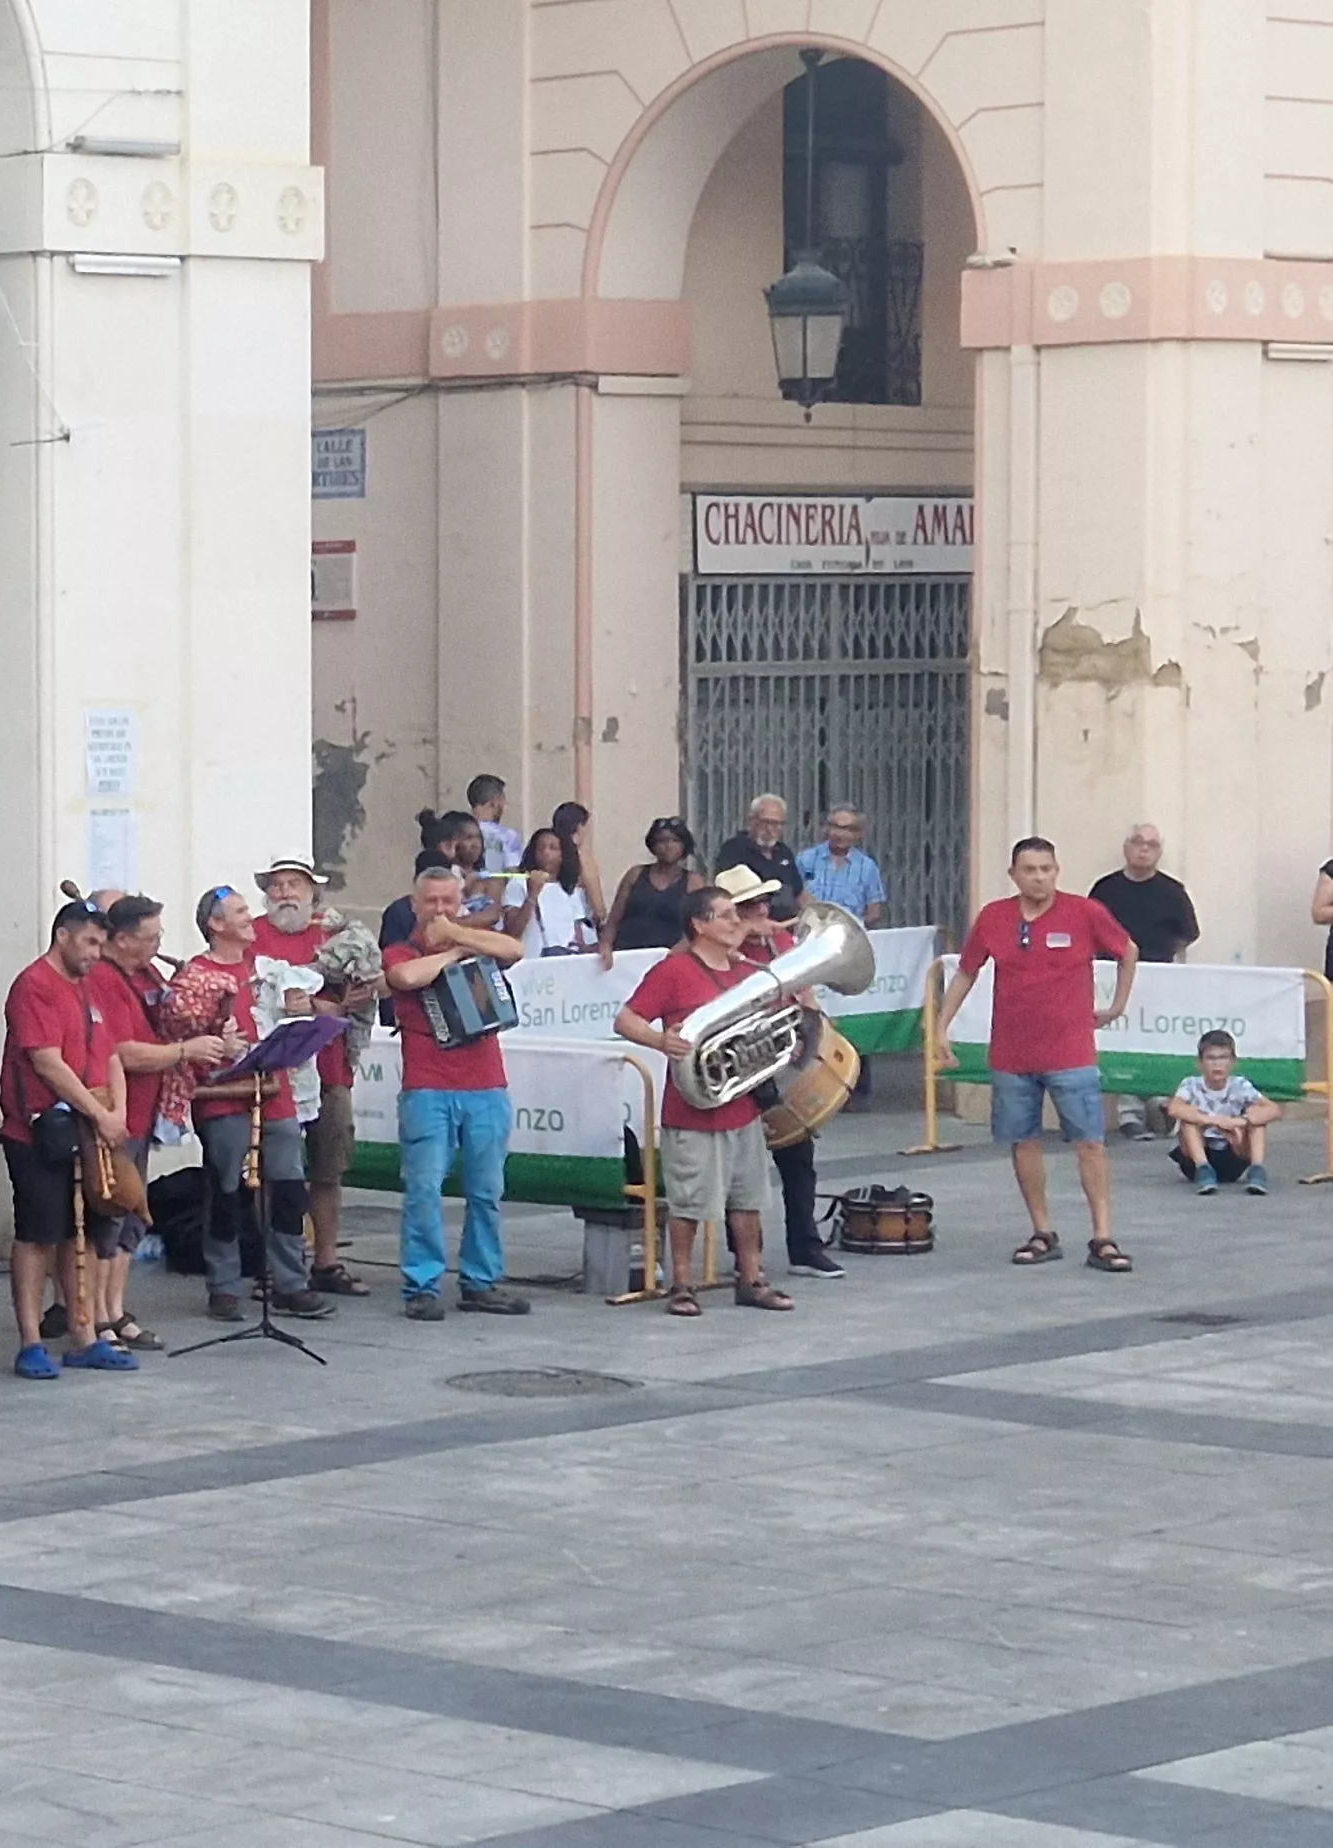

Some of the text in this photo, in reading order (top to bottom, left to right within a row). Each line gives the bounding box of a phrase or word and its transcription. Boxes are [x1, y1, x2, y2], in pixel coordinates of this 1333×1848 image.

[705, 502, 863, 546] CHACINERIA
[520, 1000, 621, 1027] San Lorenz
[1140, 1007, 1246, 1037] Lorenzo
